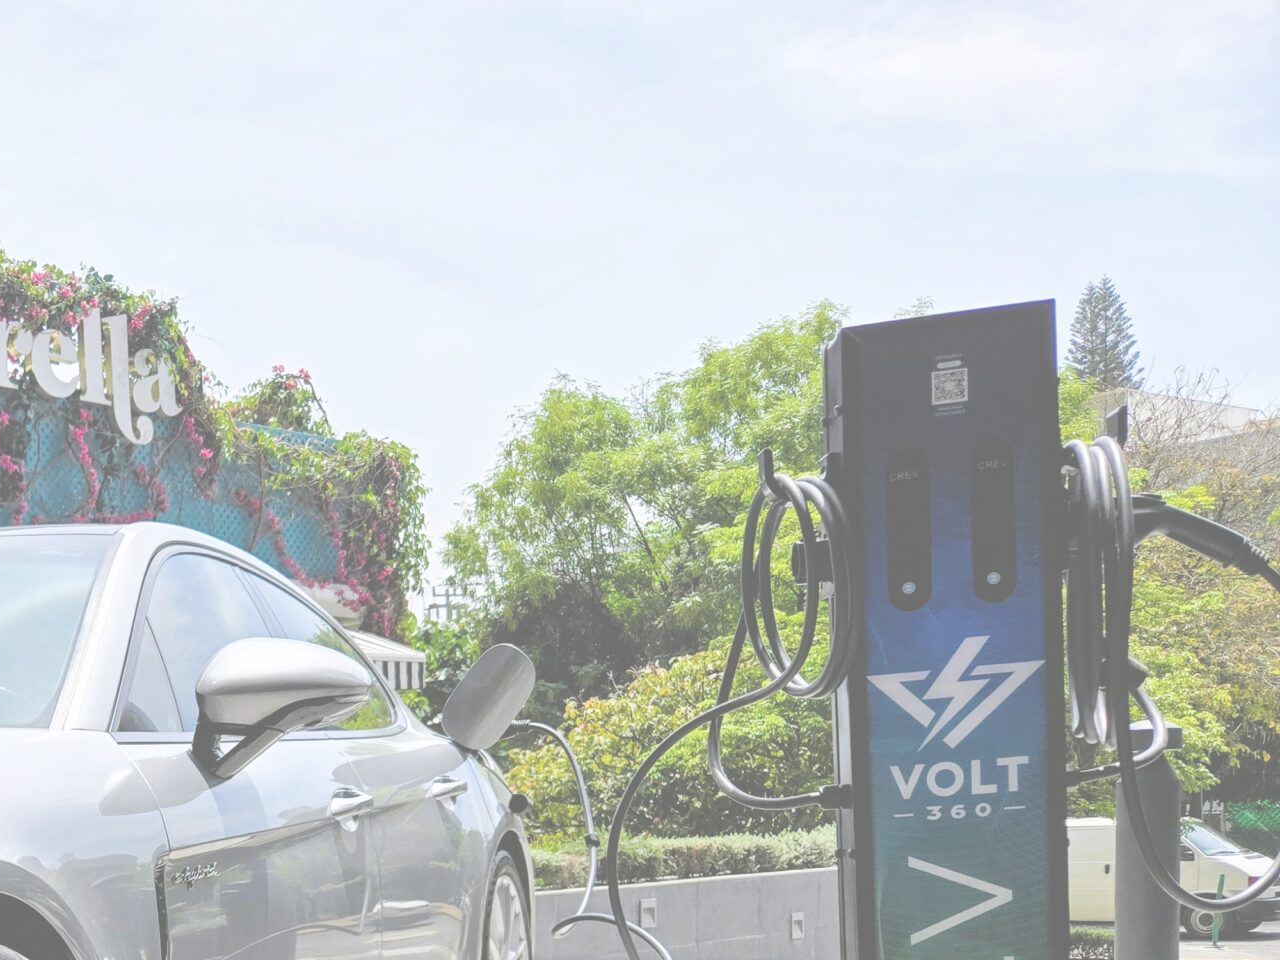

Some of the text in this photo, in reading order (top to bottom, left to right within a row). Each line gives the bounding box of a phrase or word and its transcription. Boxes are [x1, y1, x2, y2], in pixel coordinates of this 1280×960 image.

[977, 459, 1008, 471] CREV
[889, 468, 920, 482] CREV
[890, 756, 1029, 800] VOLT
[926, 804, 992, 821] 360
